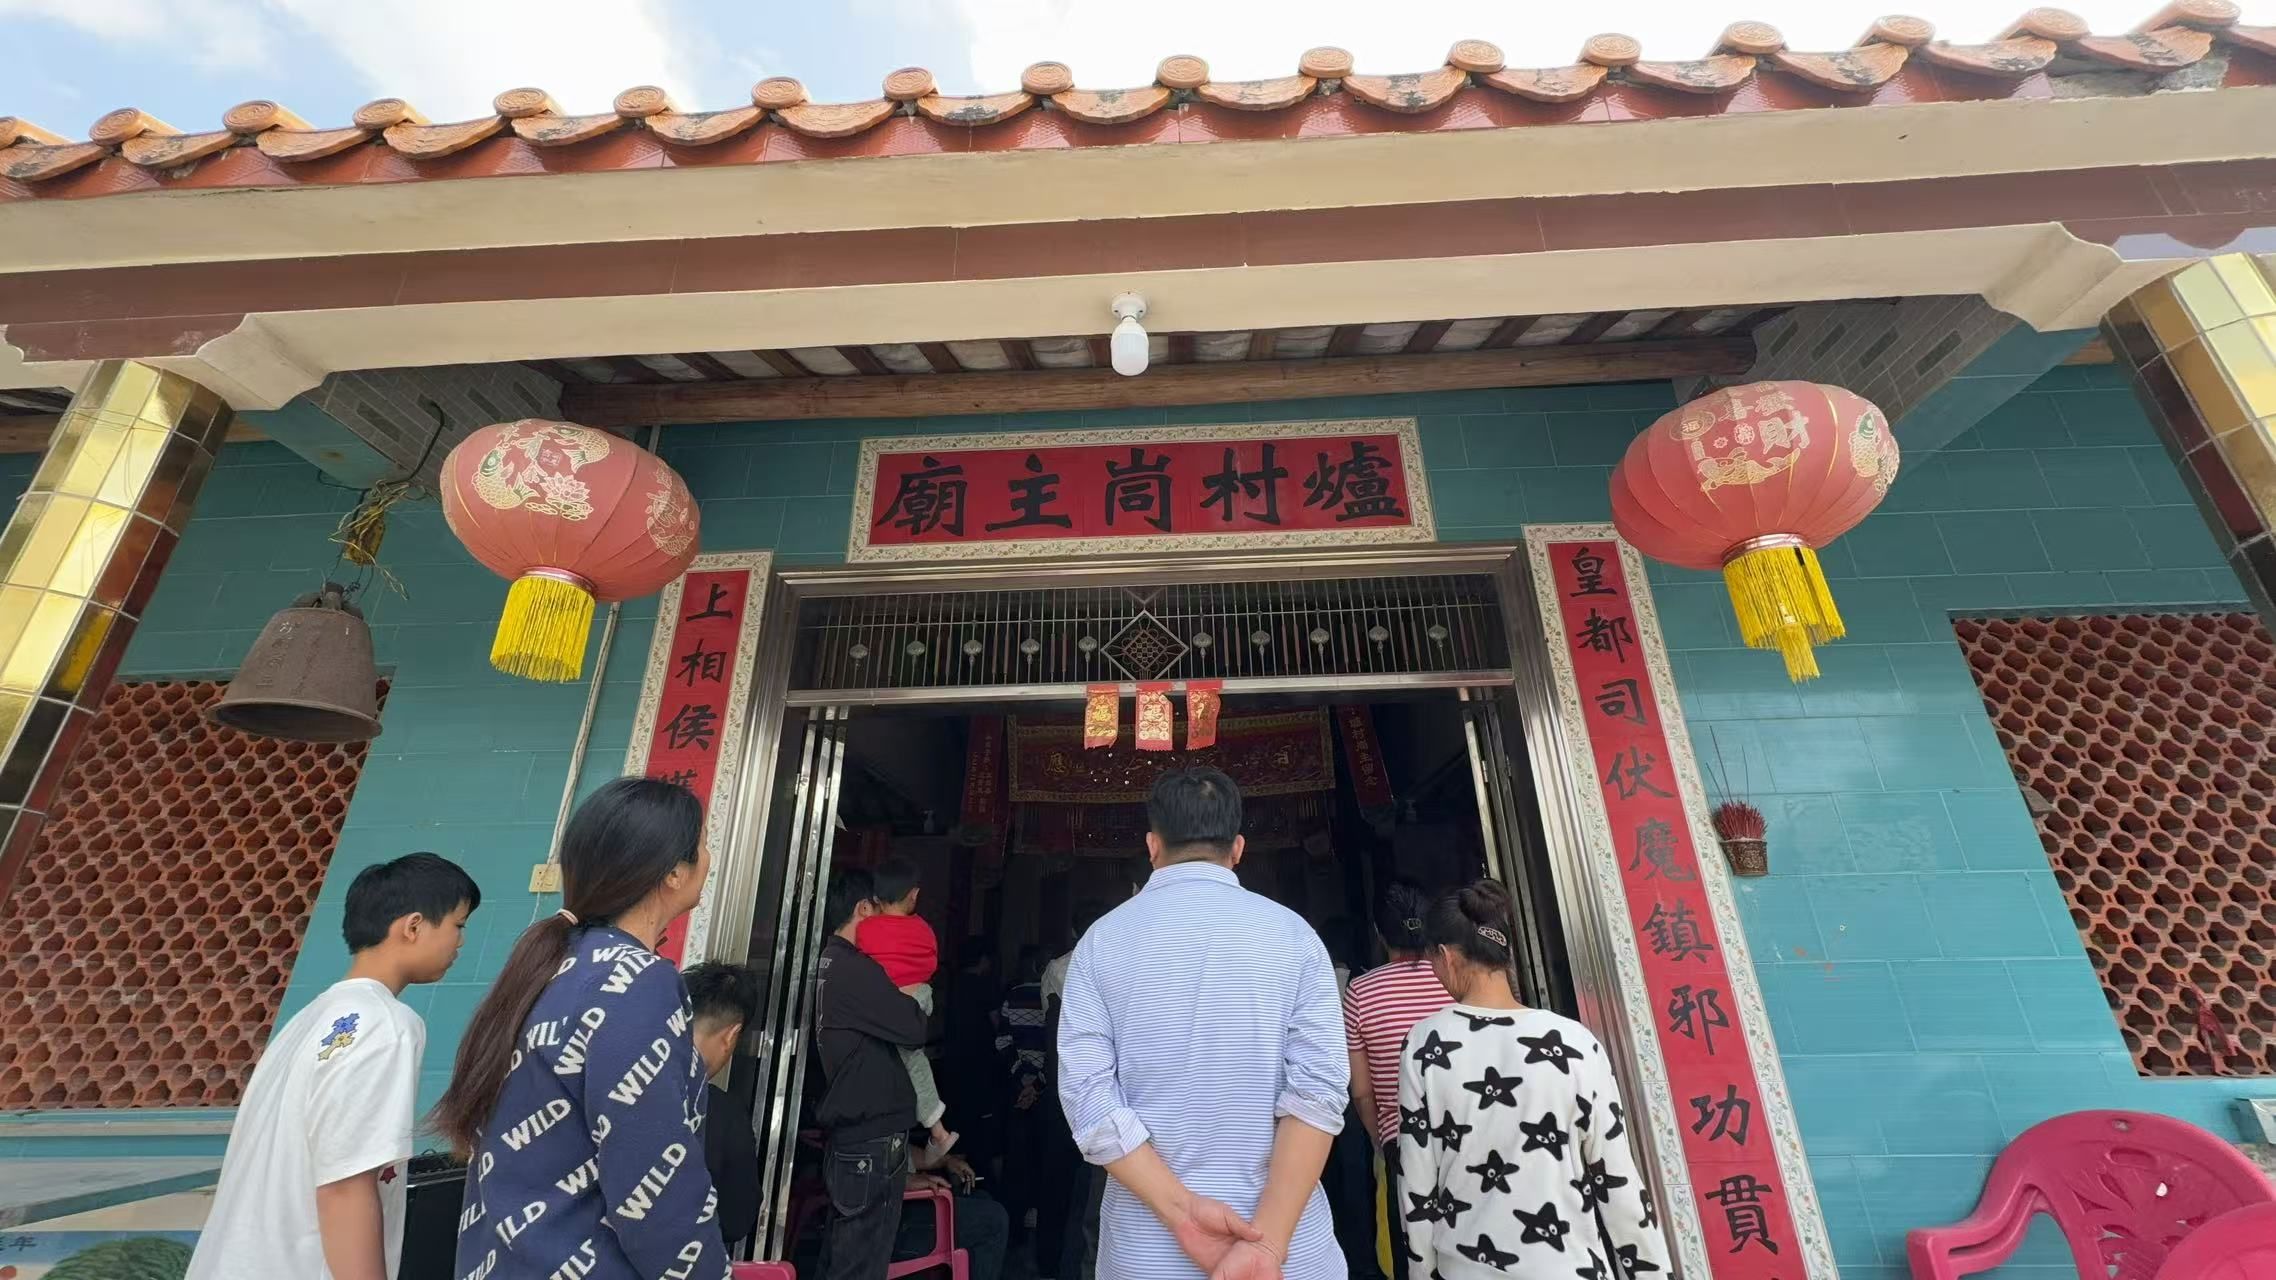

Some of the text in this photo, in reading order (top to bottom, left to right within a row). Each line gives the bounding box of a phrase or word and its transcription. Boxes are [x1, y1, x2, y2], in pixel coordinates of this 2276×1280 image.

[553, 1007, 606, 1075] WILD
[608, 1037, 671, 1106] WILD
[501, 1099, 571, 1151] WILD
[616, 1143, 687, 1221] WILD
